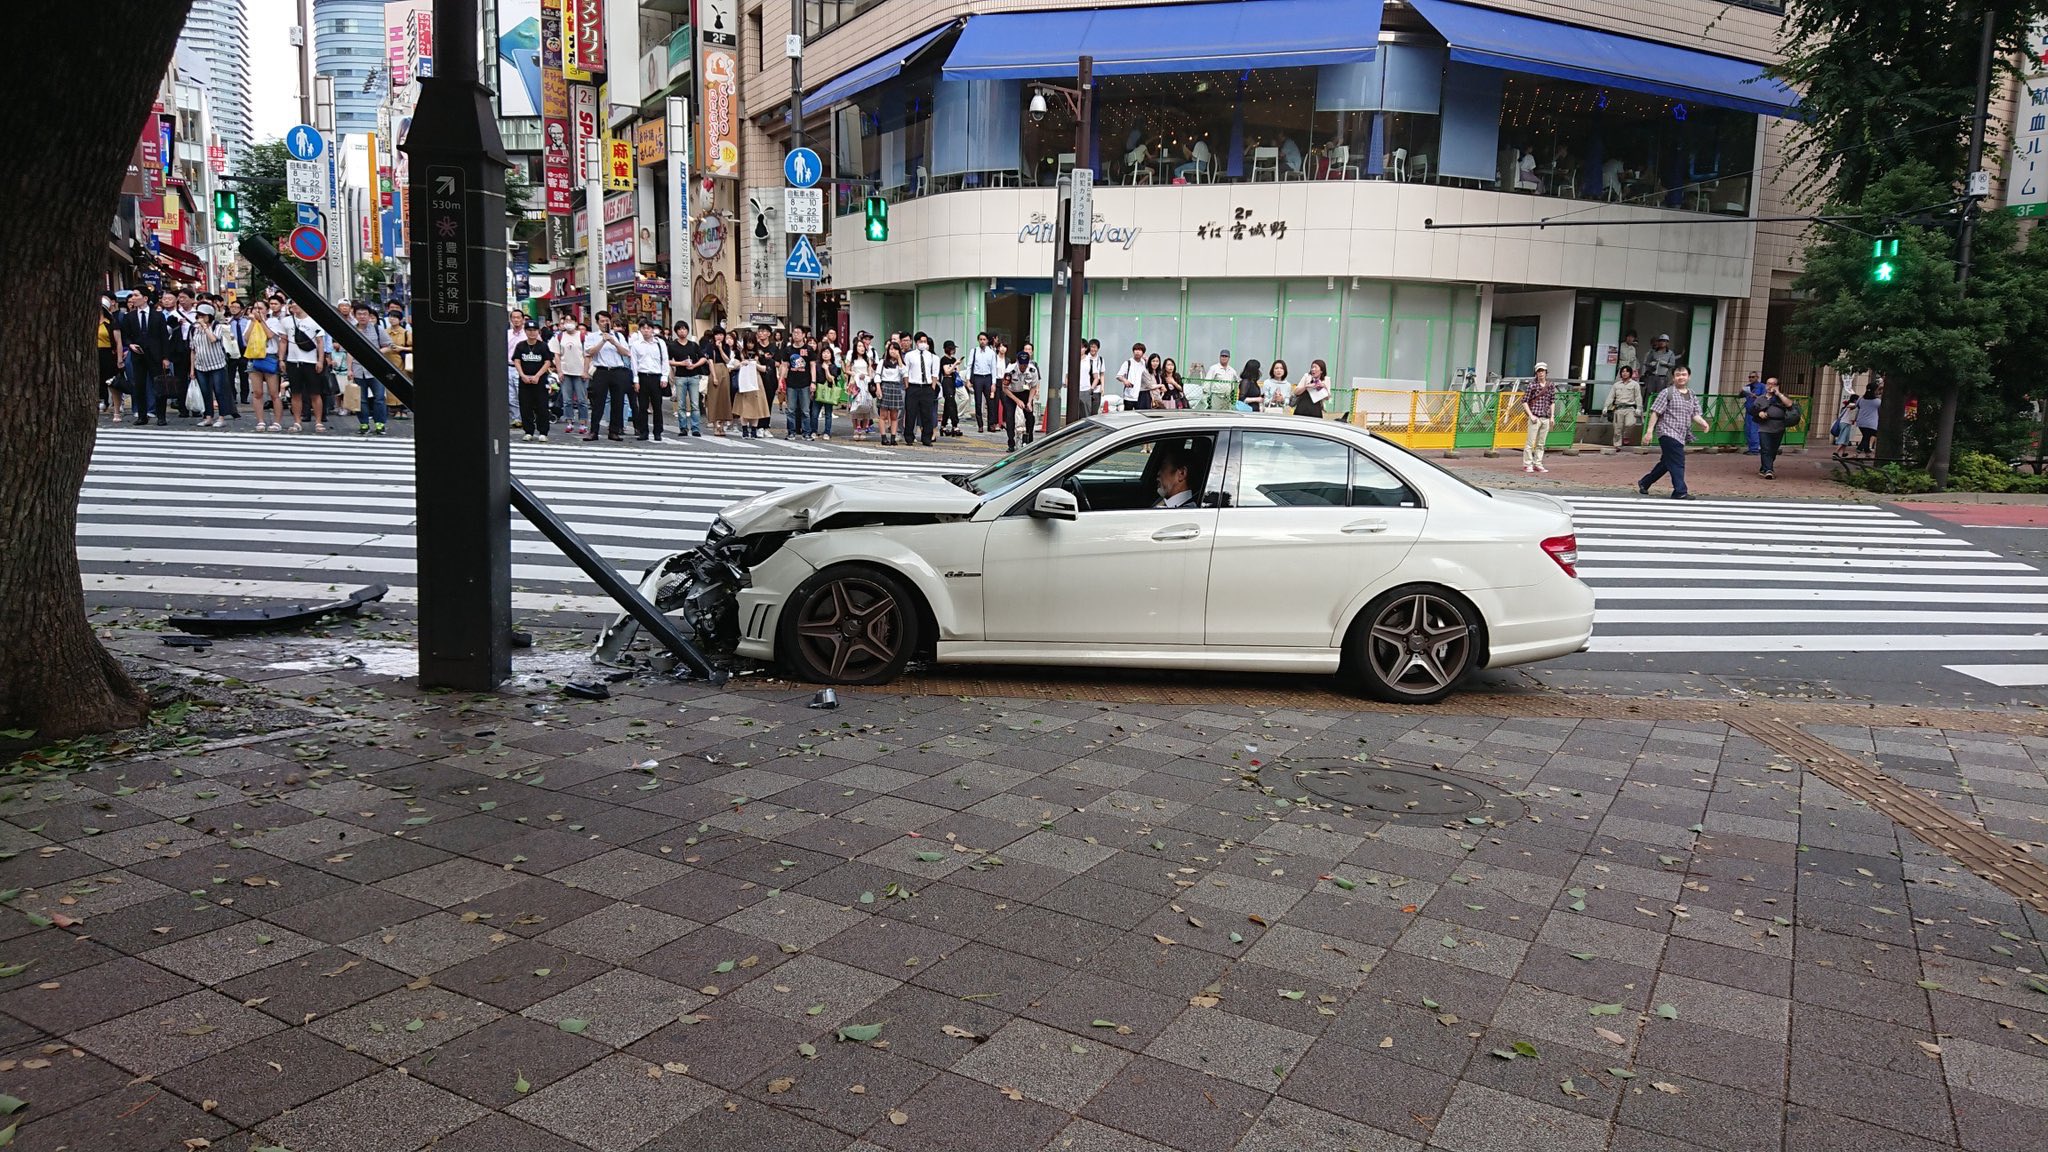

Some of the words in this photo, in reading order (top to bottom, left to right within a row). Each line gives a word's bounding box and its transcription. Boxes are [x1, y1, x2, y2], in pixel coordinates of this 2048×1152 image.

[583, 0, 598, 62] メンカフェ
[712, 33, 727, 43] 2F
[580, 90, 593, 103] 2F
[548, 156, 568, 164] KFC
[612, 143, 629, 177] 麻雀
[432, 200, 461, 210] 530m
[1078, 171, 1086, 234] 防犯カメラ作動中
[1234, 206, 1253, 220] 2F
[2016, 205, 2035, 217] 3F
[1018, 223, 1056, 243] Mil
[445, 241, 459, 315] 豊島区役所
